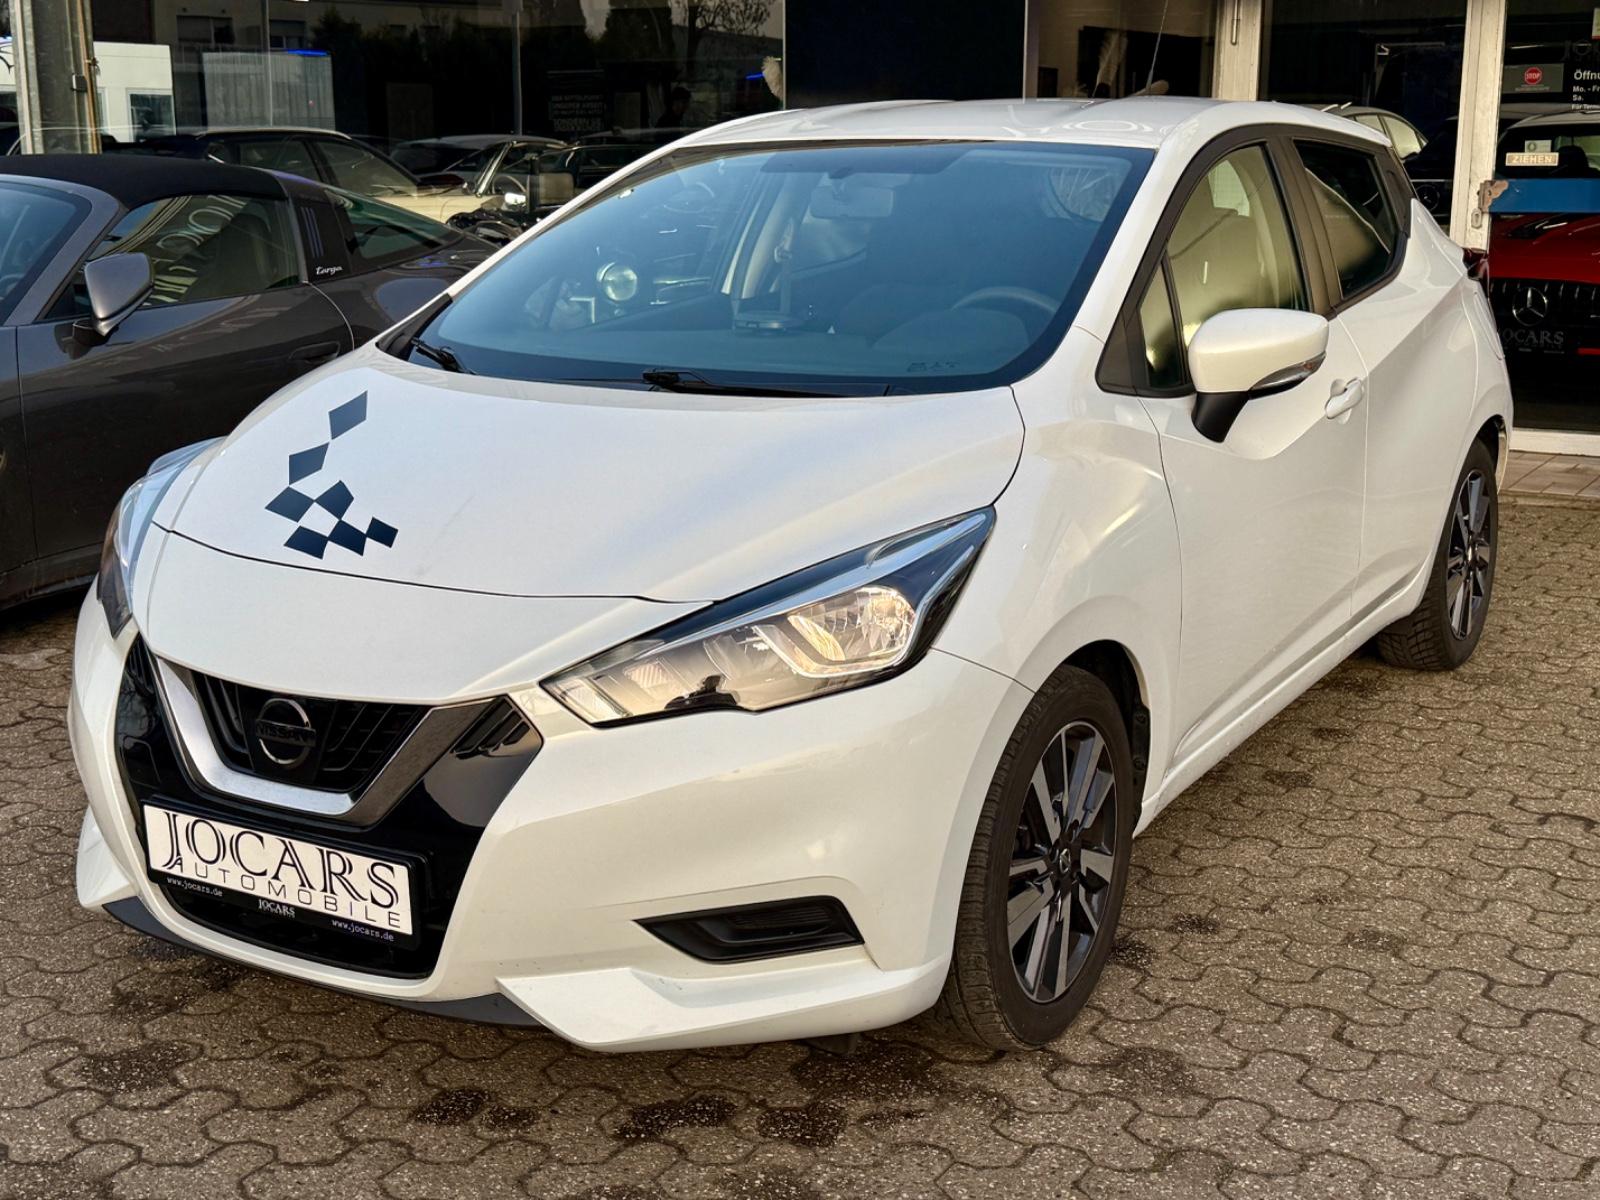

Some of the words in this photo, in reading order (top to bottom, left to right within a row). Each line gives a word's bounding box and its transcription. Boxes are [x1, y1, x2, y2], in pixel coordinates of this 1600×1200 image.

[1512, 155, 1553, 164] ZIEHEN
[162, 811, 400, 909] JOCARS
[166, 876, 223, 897] www.jocars.de
[166, 855, 401, 928] AUTOMOBILE
[258, 898, 295, 917] JOCARS
[331, 917, 395, 942] www.jocars.de
